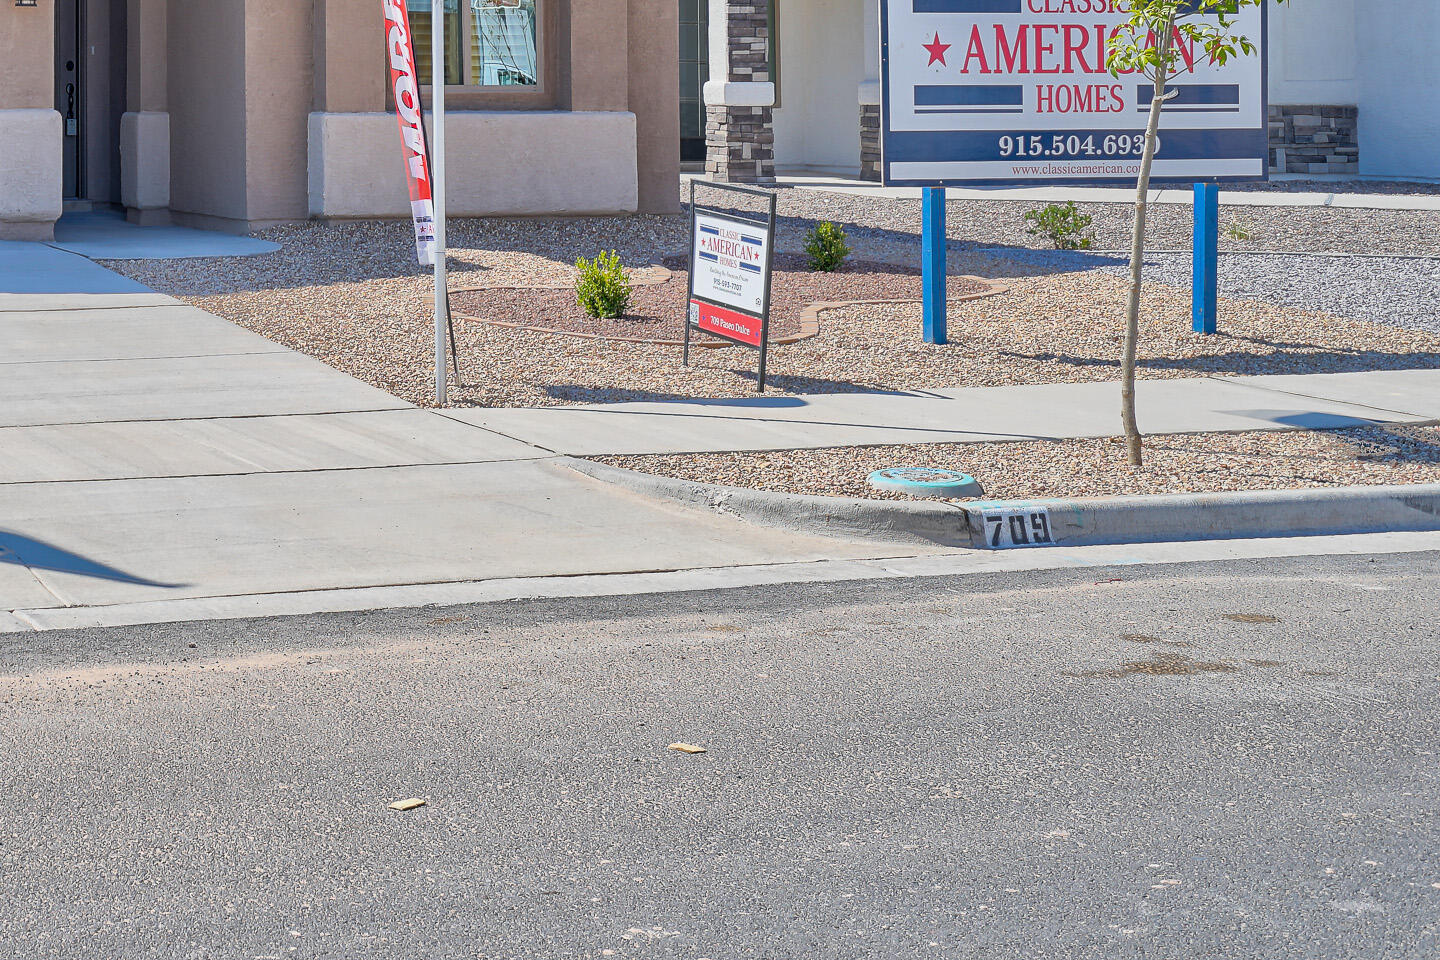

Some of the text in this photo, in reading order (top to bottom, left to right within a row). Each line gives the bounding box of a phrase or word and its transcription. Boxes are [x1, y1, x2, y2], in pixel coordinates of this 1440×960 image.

[1035, 84, 1125, 113] HOMES
[1011, 162, 1142, 176] www.classicamerican.co
[707, 236, 753, 261] AMERICAN
[710, 315, 751, 336] 709 Paseo Dulce
[986, 512, 1051, 547] 709
